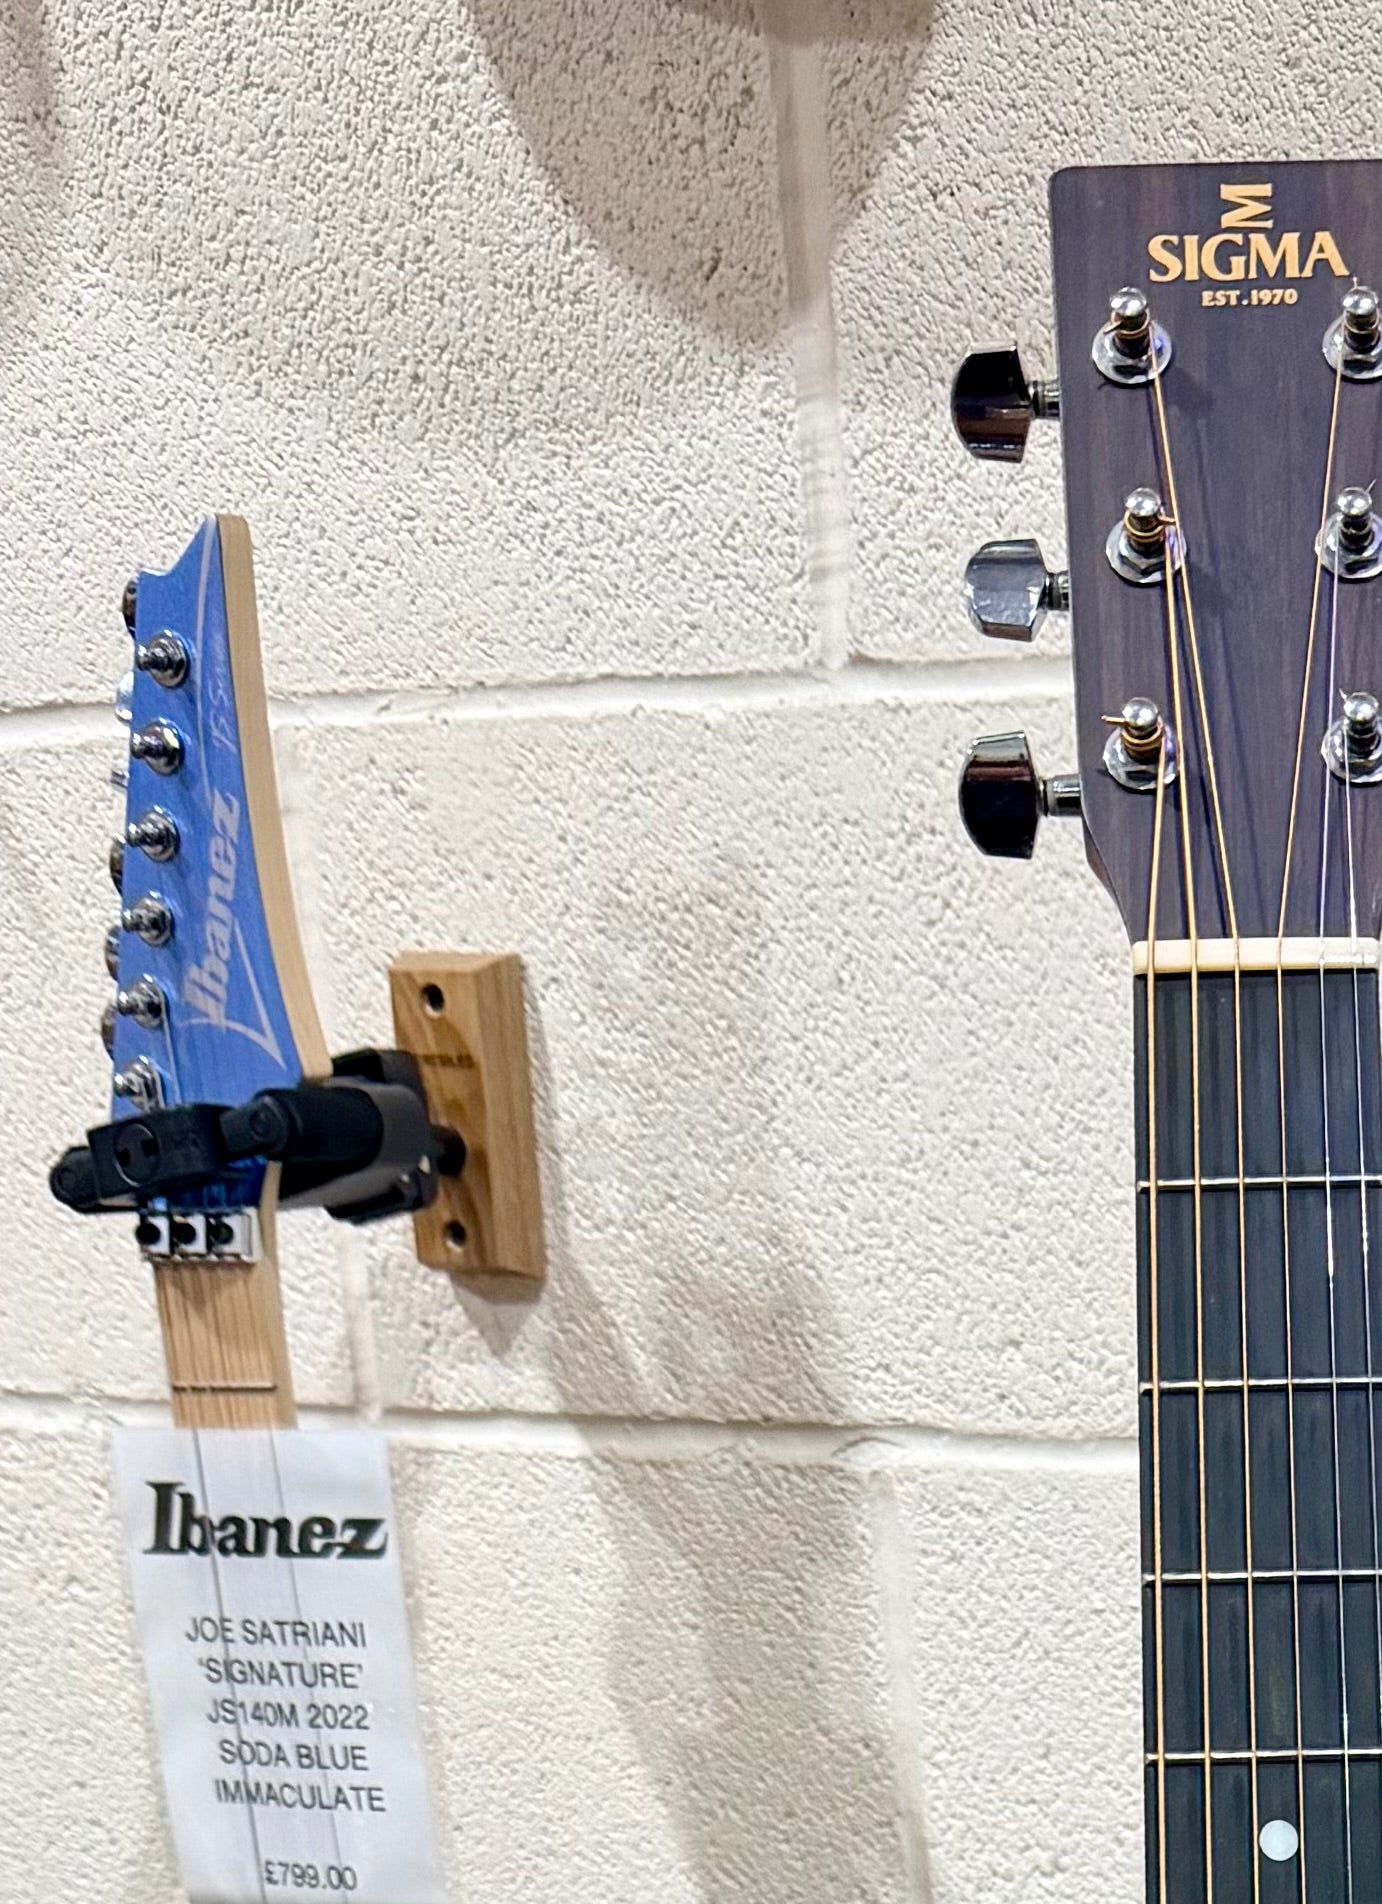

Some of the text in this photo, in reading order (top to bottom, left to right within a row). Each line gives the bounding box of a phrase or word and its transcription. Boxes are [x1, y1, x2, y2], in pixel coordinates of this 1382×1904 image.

[1148, 231, 1350, 282] SIGMA
[181, 789, 240, 1033] Ibanez
[143, 1479, 388, 1560] Ibanez
[185, 1616, 368, 1648] JOE SATRIANI
[206, 1703, 370, 1731] JS140M 2022
[219, 1740, 369, 1772] SODA BLUE
[215, 1779, 387, 1813] IMMACULATE
[264, 1861, 358, 1891] £799.00
